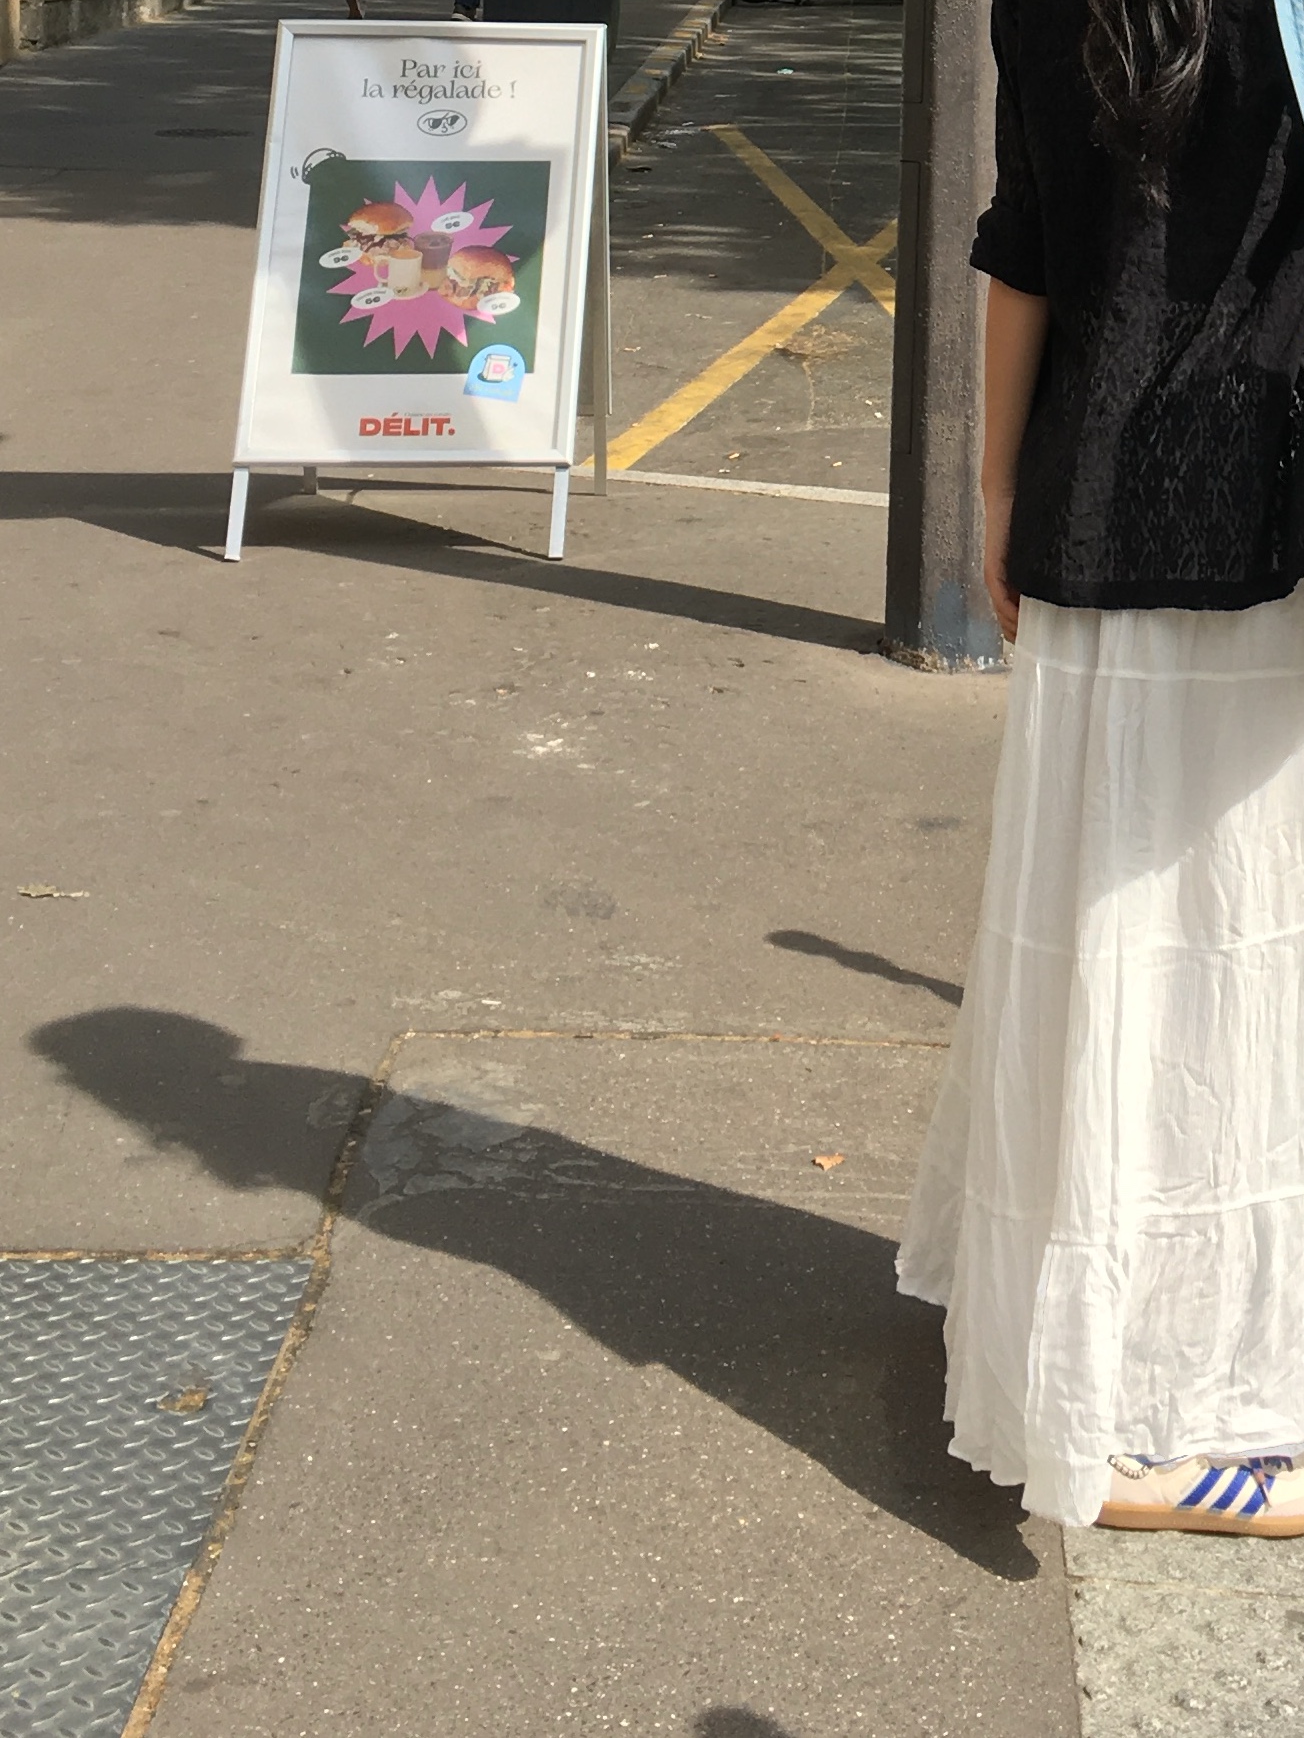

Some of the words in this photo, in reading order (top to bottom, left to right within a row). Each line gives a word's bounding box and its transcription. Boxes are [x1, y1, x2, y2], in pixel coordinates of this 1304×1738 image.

[400, 58, 446, 78] Par
[453, 60, 483, 79] ici
[361, 78, 385, 99] la
[391, 79, 503, 105] régalade
[359, 412, 456, 436] DÉLIT.
